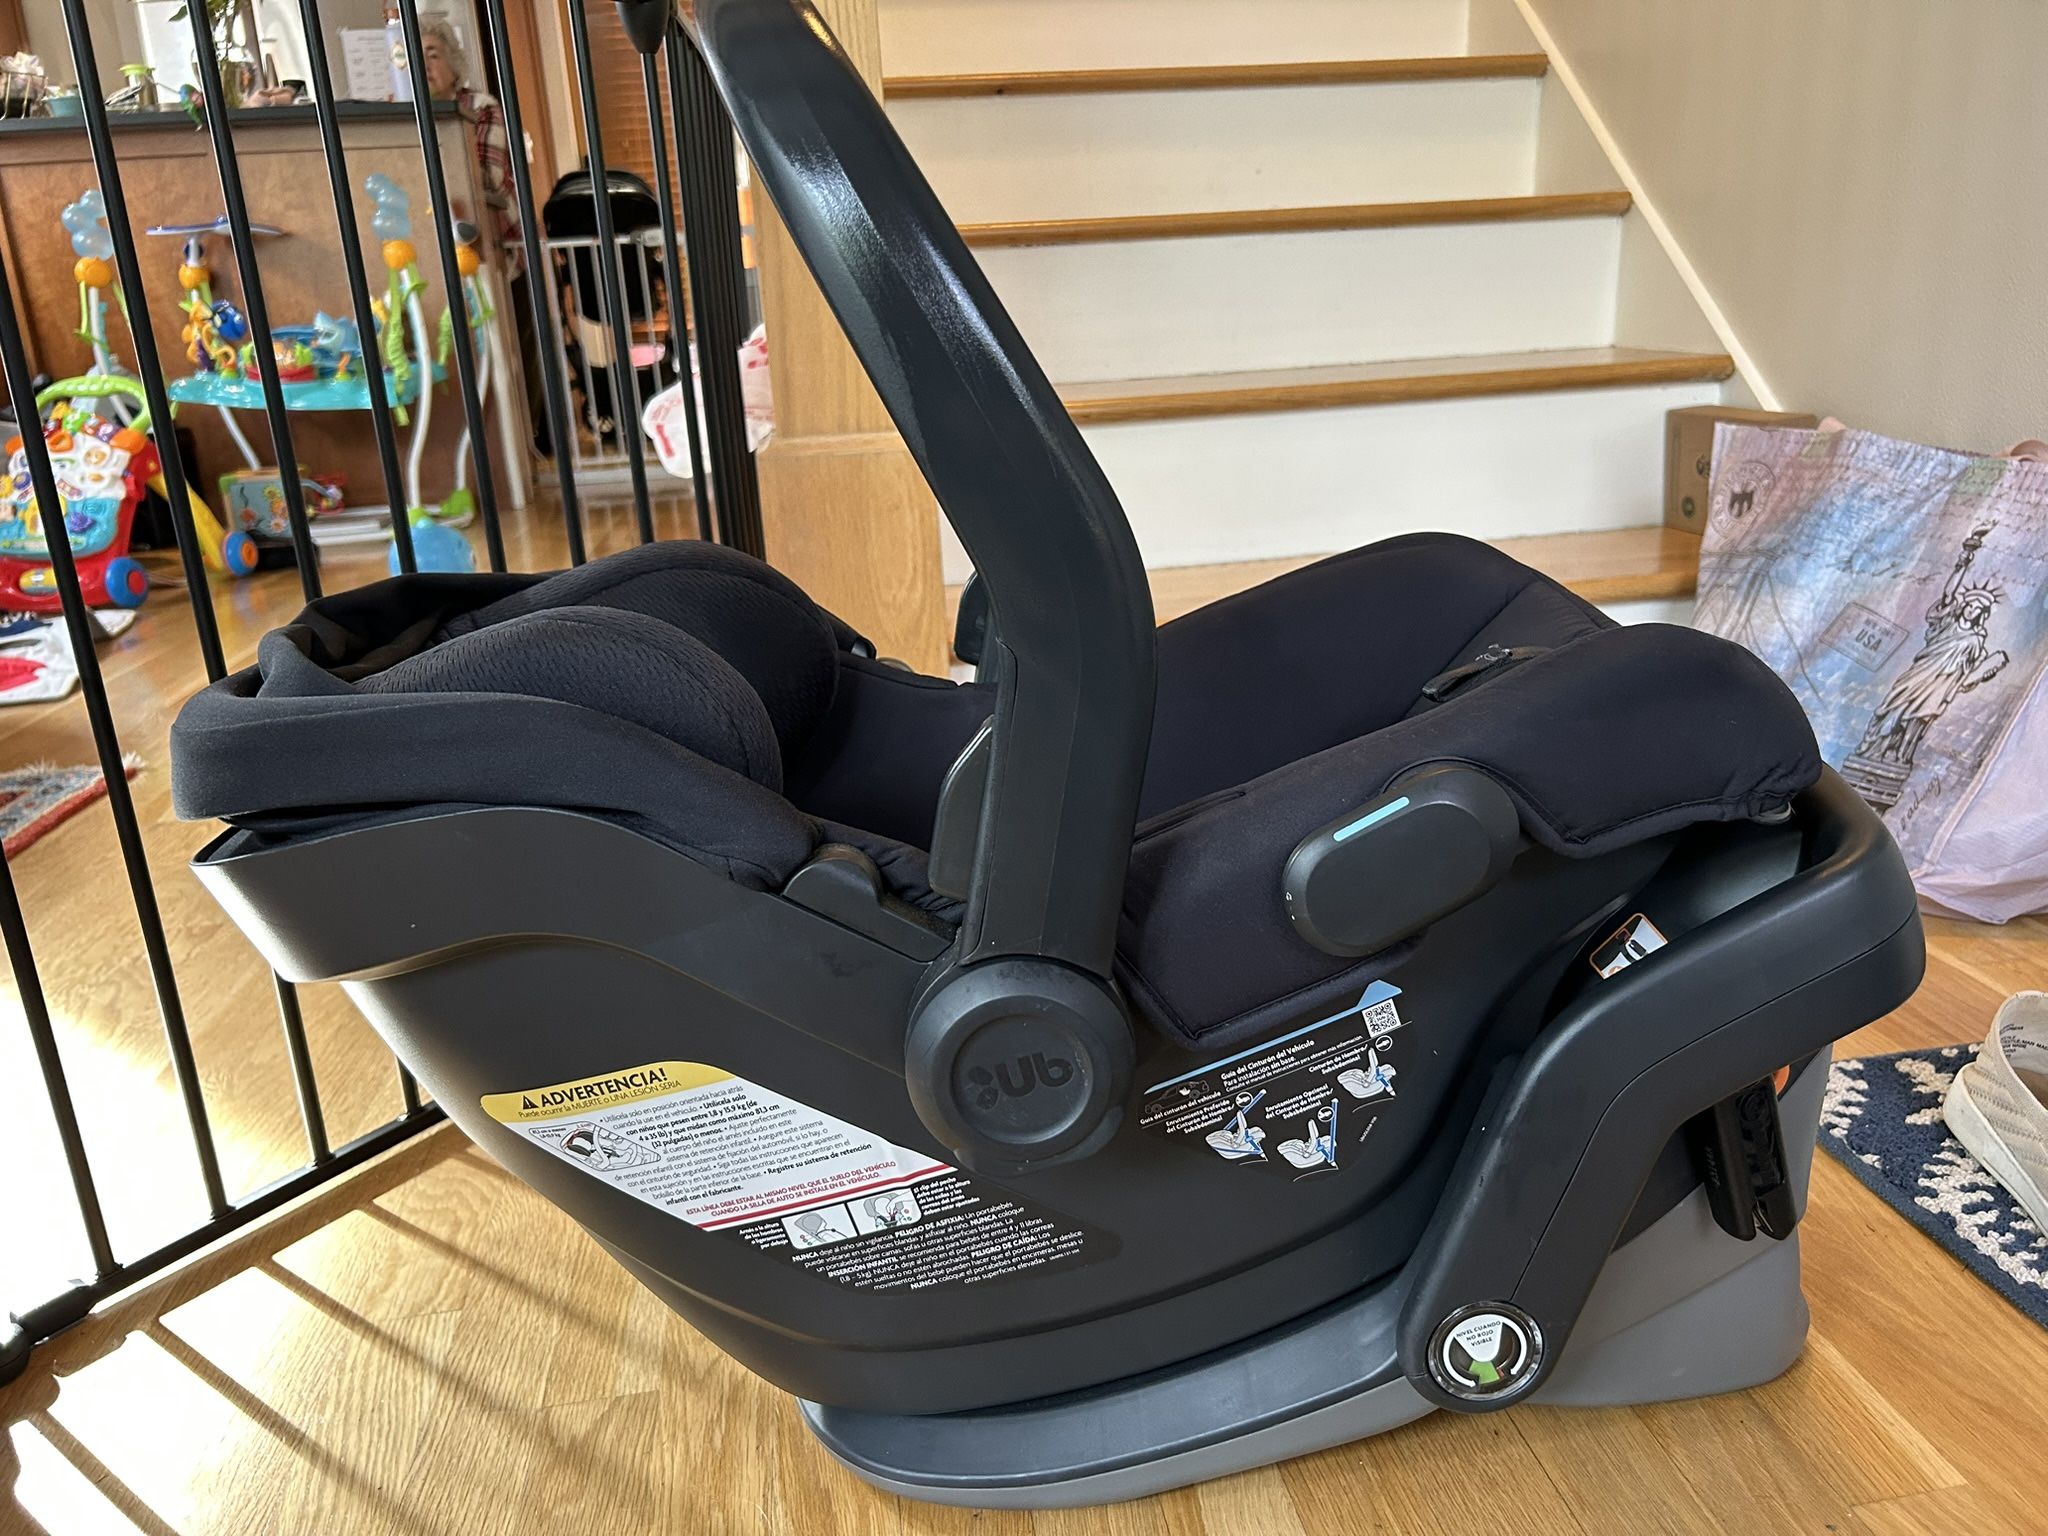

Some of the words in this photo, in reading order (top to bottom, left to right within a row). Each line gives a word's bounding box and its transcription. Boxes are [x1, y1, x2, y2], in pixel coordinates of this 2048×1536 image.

[1855, 629, 1882, 652] USA
[1221, 1071, 1235, 1079] Guía
[1236, 1065, 1247, 1074] del
[1247, 1055, 1275, 1069] Cinturón
[1276, 1049, 1286, 1058] del
[1286, 1040, 1314, 1054] Vehículo
[1223, 1078, 1237, 1086] Para
[1237, 1065, 1270, 1081] instalación
[518, 1107, 539, 1118] Puede
[540, 1107, 562, 1115] ocurrir
[571, 1098, 602, 1109] MUERTE
[609, 1092, 628, 1101] UNA
[629, 1085, 658, 1097] LESIÓN
[659, 1080, 681, 1090] SERIA
[541, 1068, 667, 1107] ADVERTENCIA!
[628, 1109, 642, 1117] solo
[651, 1101, 677, 1113] posición
[679, 1093, 709, 1105] orientada
[727, 1085, 743, 1094] atrás
[612, 1120, 635, 1129] cuando
[662, 1133, 693, 1146] pulgadas)
[729, 1121, 748, 1130] Ajuste
[749, 1109, 796, 1126] perfectamente
[670, 1117, 690, 1127] pesen
[723, 1104, 735, 1112] 15,9
[686, 1122, 707, 1131] midan
[727, 1111, 754, 1121] máximo
[755, 1106, 767, 1114] 81,3
[666, 1153, 689, 1162] sistema
[699, 1144, 728, 1154] retención
[758, 1130, 782, 1141] Asegure
[798, 1120, 823, 1130] sistema
[669, 1144, 691, 1152] cuerpo
[725, 1132, 741, 1140] arnés
[742, 1125, 767, 1135] incluido
[646, 1174, 671, 1183] cinturón
[730, 1157, 748, 1165] todas
[759, 1144, 799, 1158] instrucciones
[814, 1133, 843, 1145] aparecen
[652, 1190, 674, 1199] bolsillo
[690, 1184, 706, 1192] parte
[708, 1179, 729, 1187] inferior
[767, 1164, 794, 1173] Registre
[804, 1155, 828, 1164] sistema
[839, 1143, 871, 1155] retención
[665, 1195, 688, 1205] infantil
[711, 1206, 739, 1216] CUANDO
[748, 1200, 765, 1208] SILLA
[776, 1193, 794, 1201] AUTO
[803, 1184, 828, 1195] INSTALE
[735, 1195, 754, 1204] ESTAR
[764, 1187, 787, 1197] MISMO
[788, 1183, 806, 1191] NIVEL
[807, 1179, 821, 1187] QUE
[829, 1172, 850, 1181] SUELO
[863, 1161, 895, 1172] VEHÍCULO
[792, 1251, 818, 1261] NUNCA
[894, 1225, 924, 1237] PELIGRO
[975, 1202, 1012, 1217] portabebés
[804, 1258, 823, 1268] puede
[825, 1252, 849, 1261] volcarse
[860, 1242, 893, 1254] superficies
[893, 1236, 918, 1245] blandas
[925, 1228, 945, 1237] asfixiar
[969, 1214, 997, 1225] NUNCA
[997, 1207, 1023, 1218] coloque
[825, 1258, 862, 1270] portabebés
[862, 1253, 879, 1261] sobre
[903, 1243, 920, 1251] sofás
[926, 1237, 943, 1245] otras
[943, 1228, 977, 1240] superficies
[827, 1263, 865, 1277] INSERCIÓN
[866, 1256, 898, 1268] INFANTIL
[907, 1245, 944, 1258] recomienda
[945, 1241, 959, 1249] para
[960, 1235, 980, 1244] bebés
[990, 1228, 1007, 1236] entre
[1024, 1218, 1042, 1226] libras
[854, 1278, 872, 1286] estén
[873, 1273, 895, 1282] sueltas
[913, 1264, 931, 1272] estén
[970, 1245, 1001, 1257] PELIGRO
[873, 1276, 915, 1289] movimientos
[927, 1268, 944, 1277] bebé
[945, 1262, 970, 1273] pueden
[970, 1256, 988, 1265] hacer
[1011, 1240, 1049, 1255] portabebés
[910, 1278, 937, 1289] NUNCA
[938, 1271, 964, 1282] coloque
[973, 1259, 1010, 1274] portabebés
[1056, 1240, 1077, 1249] mesas
[964, 1275, 980, 1283] otras
[981, 1265, 1016, 1278] superficies
[1457, 1329, 1473, 1337] NIVEL
[1474, 1321, 1501, 1332] CUANDO
[1471, 1337, 1492, 1346] VISIBLE
[1477, 1330, 1494, 1338] ROJO
